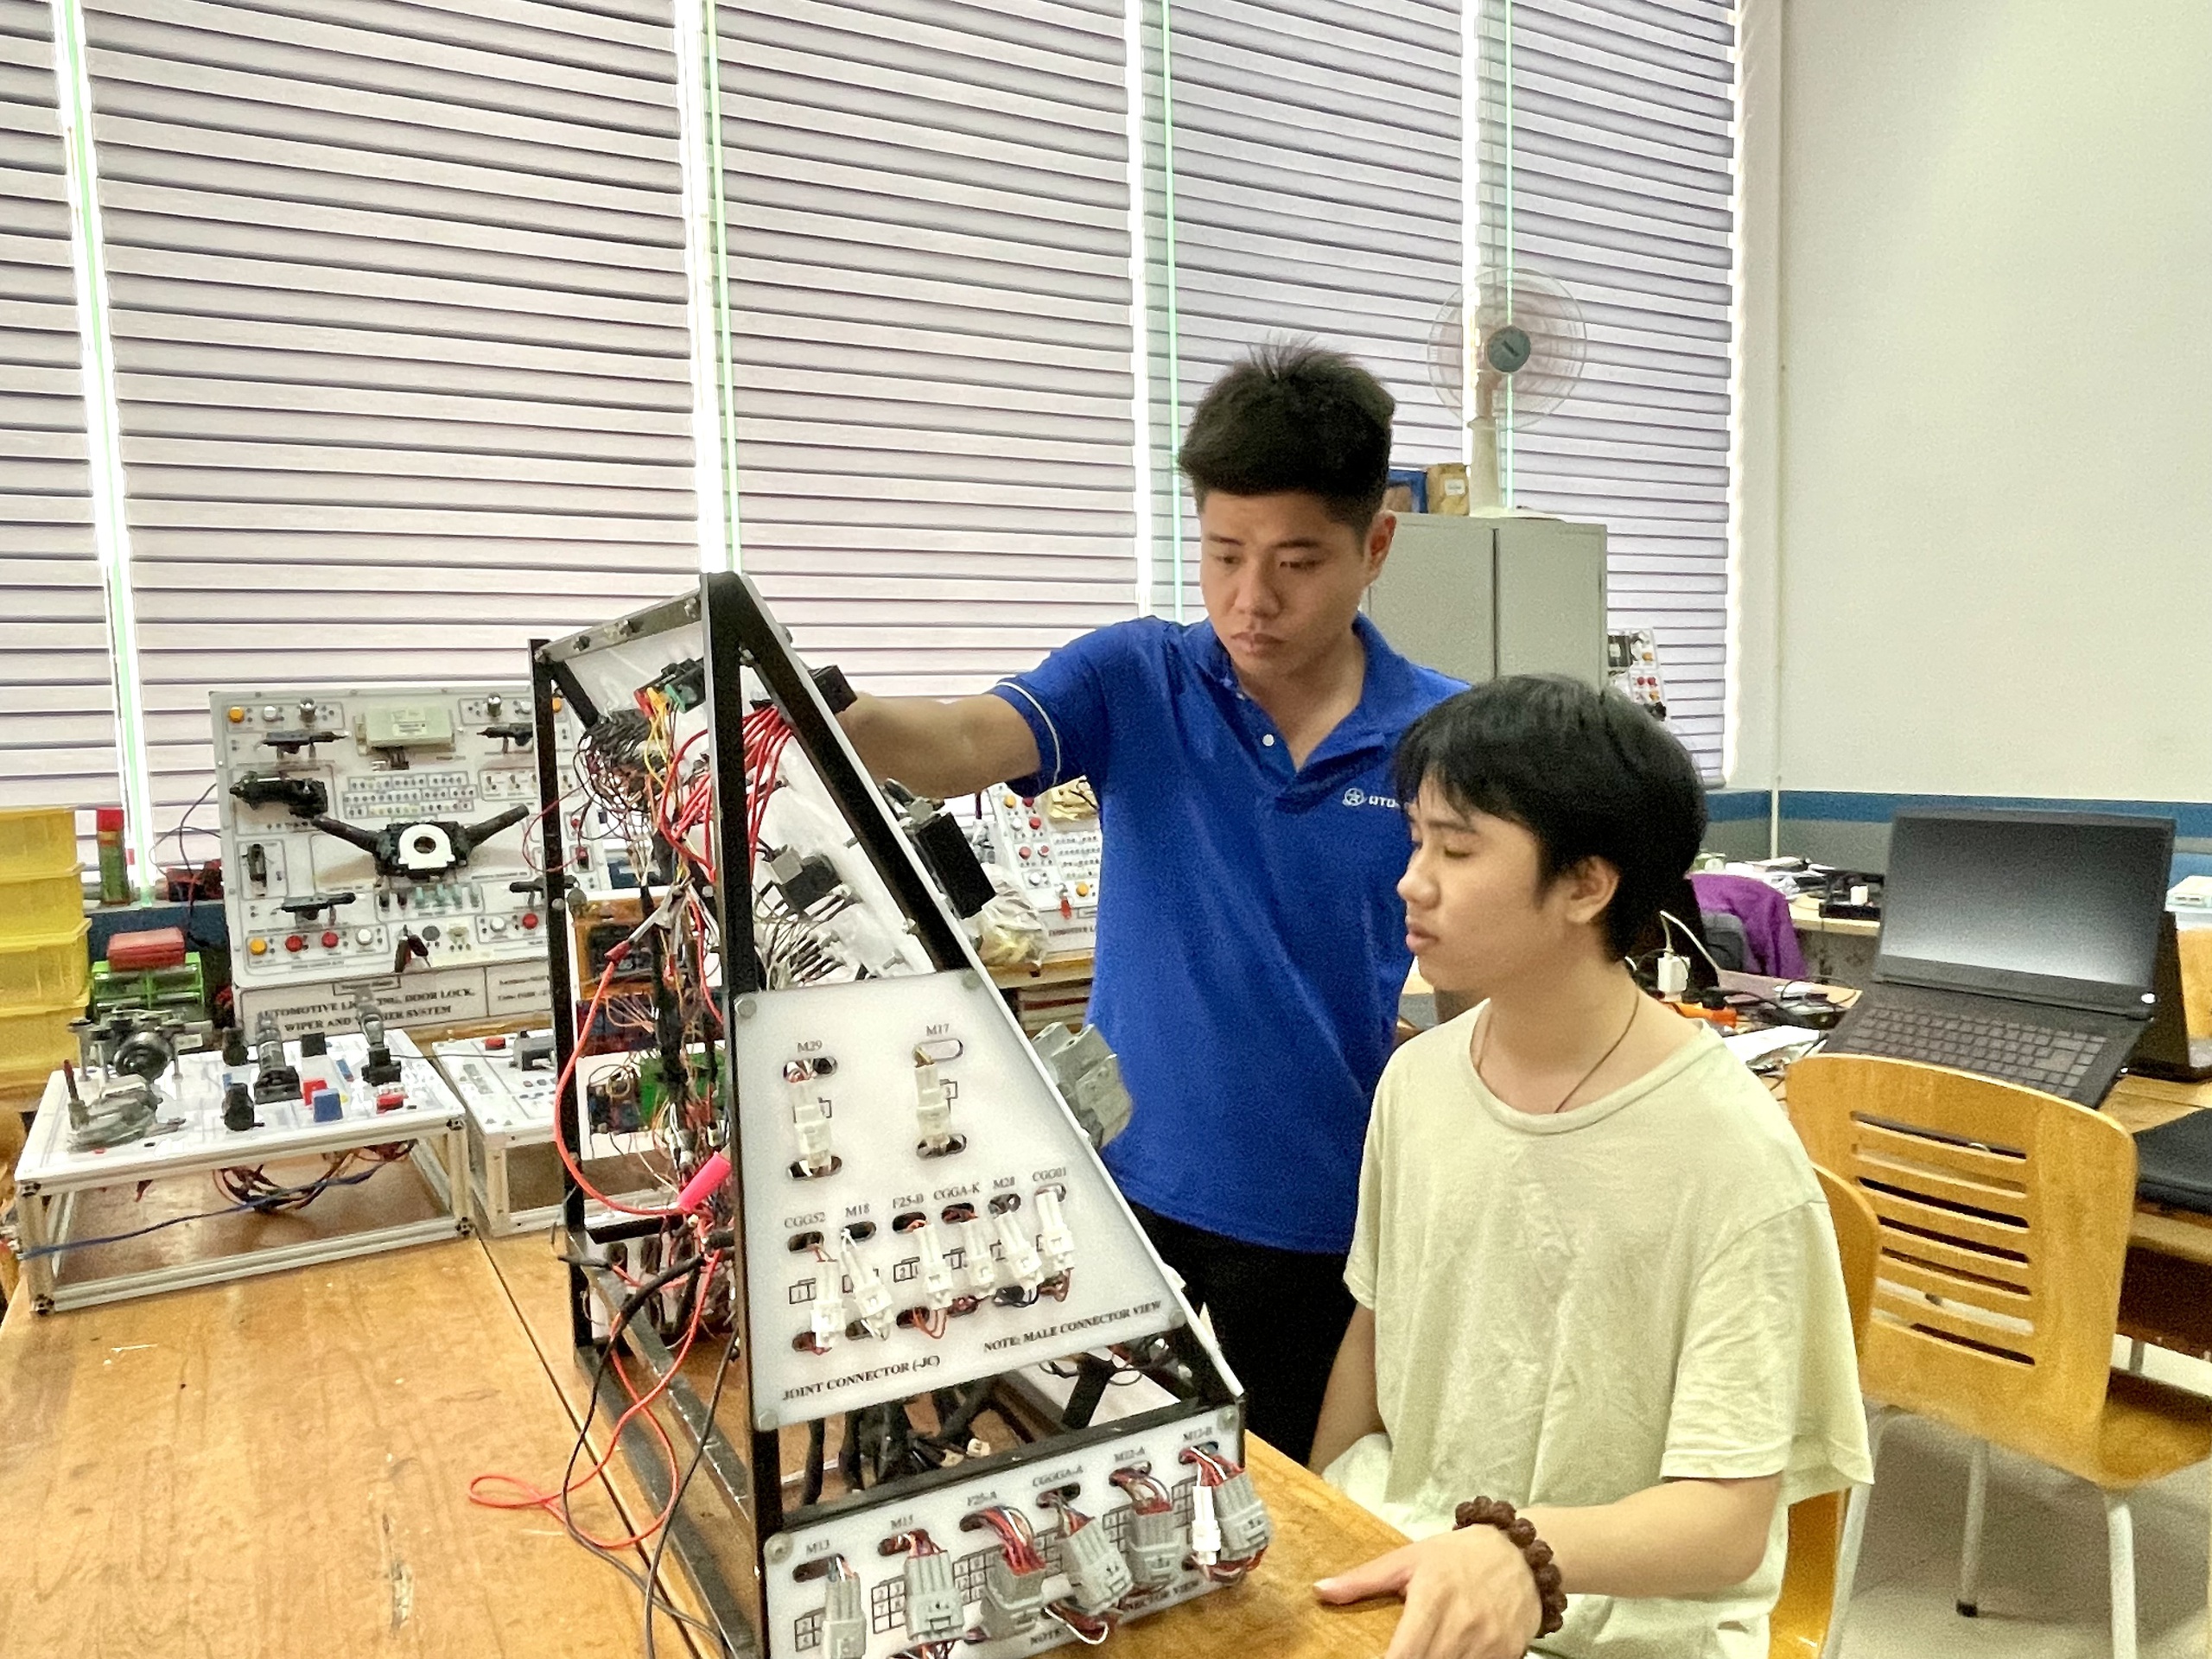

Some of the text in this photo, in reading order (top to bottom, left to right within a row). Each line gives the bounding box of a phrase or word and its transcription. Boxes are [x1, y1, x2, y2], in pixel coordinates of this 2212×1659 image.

[257, 1003, 338, 1017] UTOMOTIVE
[404, 992, 437, 1002] DOOR
[284, 1020, 323, 1032] WIPER
[327, 1018, 352, 1027] AND
[406, 1005, 451, 1017] SYSTEM
[925, 1023, 950, 1036] M17
[797, 1040, 823, 1052] M29
[845, 1203, 871, 1217] M18
[1023, 1326, 1058, 1343] MALE
[1059, 1308, 1130, 1332] CONNECTOR
[1132, 1300, 1161, 1315] VIEW
[783, 1383, 823, 1401] JOINT
[826, 1362, 909, 1390] CONNECTOR
